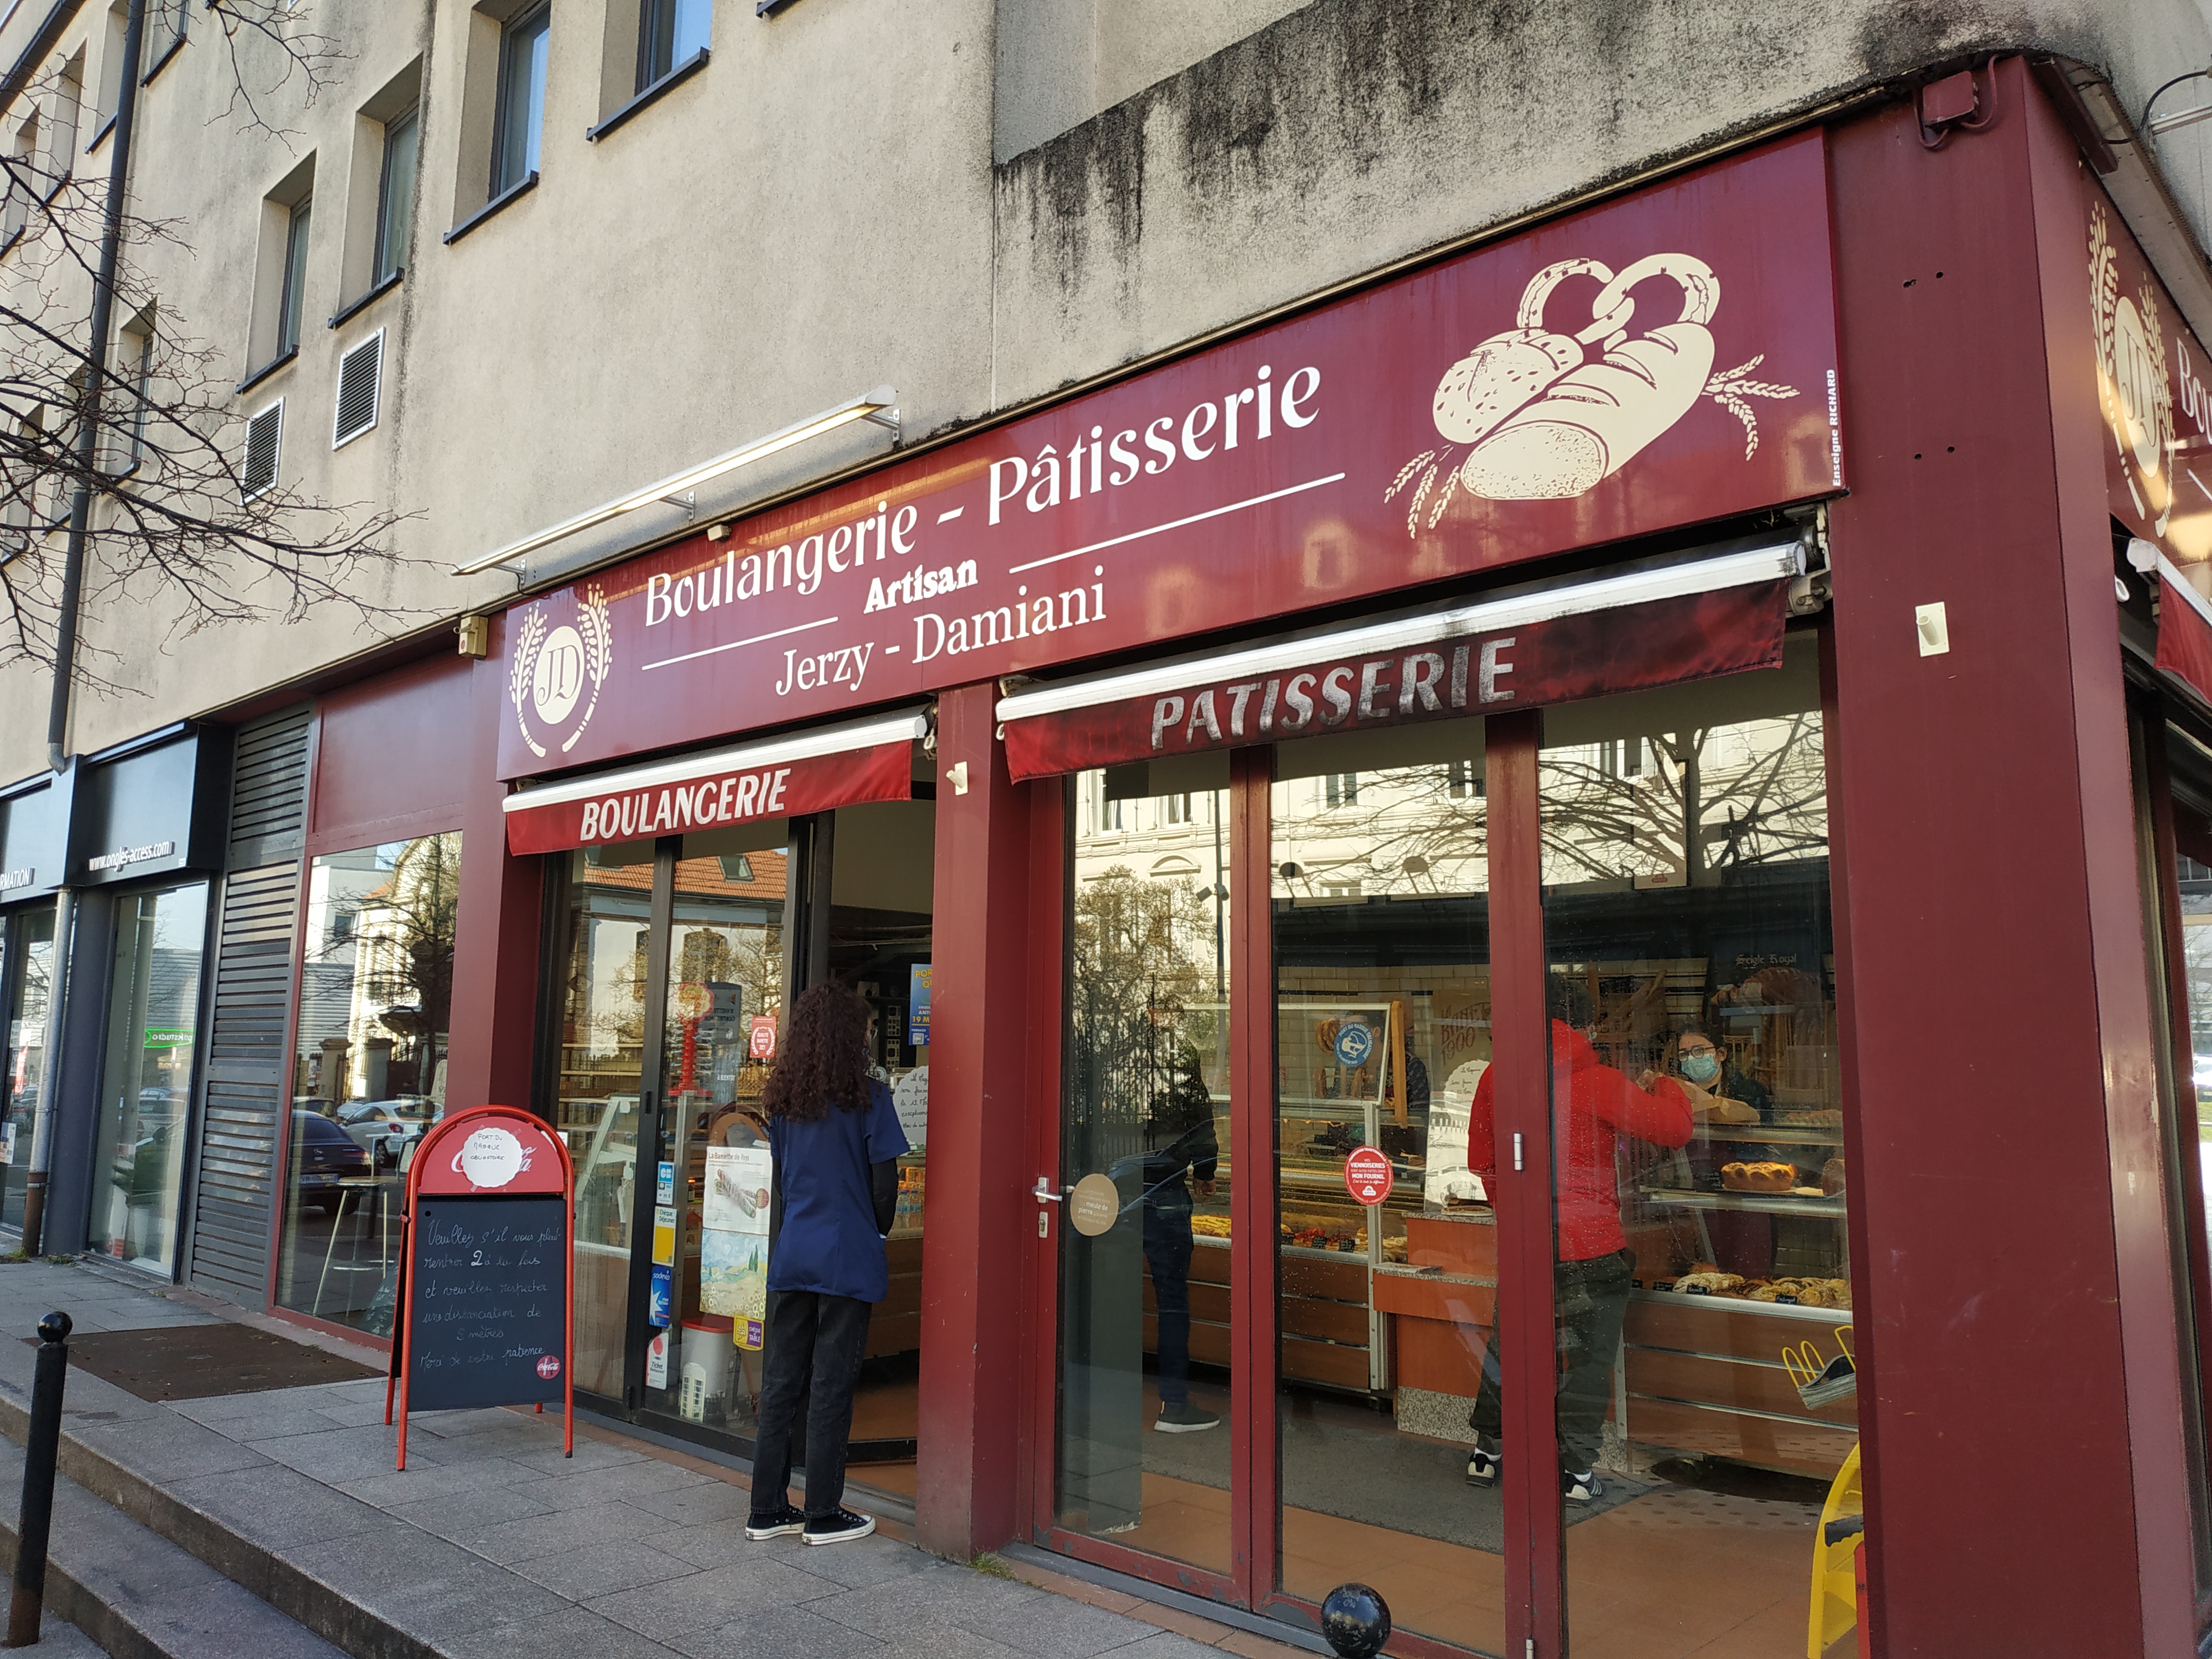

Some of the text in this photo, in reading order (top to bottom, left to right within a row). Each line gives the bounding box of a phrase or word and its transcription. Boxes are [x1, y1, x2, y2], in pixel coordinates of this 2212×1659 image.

[1827, 369, 1841, 487] Enseigne RICHARD
[644, 501, 918, 627] Boulangerie
[989, 366, 1321, 525] Pâtisserie
[864, 559, 978, 614] Artisan
[775, 641, 874, 696] Jerzy
[912, 566, 1107, 664] Damiani
[535, 643, 579, 706] JD
[1151, 637, 1516, 750] PATISSERIE
[579, 768, 791, 841] BOULANGERIE
[88, 841, 169, 872] www.ongles-access.com
[0, 868, 30, 889] RMATION
[1770, 953, 1797, 966] Royal
[1442, 1026, 1476, 1066] 1900
[473, 1142, 500, 1150] MASQUE
[740, 1153, 749, 1162] Pays
[1078, 1207, 1093, 1215] pierre
[1086, 1202, 1101, 1210] meule
[427, 1218, 474, 1249] Veuillez
[512, 1233, 534, 1242] vous
[424, 1253, 462, 1269] rentrer
[471, 1250, 483, 1266] 2
[517, 1250, 541, 1268] fois
[653, 1272, 670, 1281] sodexo
[425, 1279, 437, 1299] et
[442, 1280, 492, 1300] veuillez
[526, 1303, 542, 1318] de
[468, 1325, 504, 1338] mètres
[502, 1343, 546, 1366] patience
